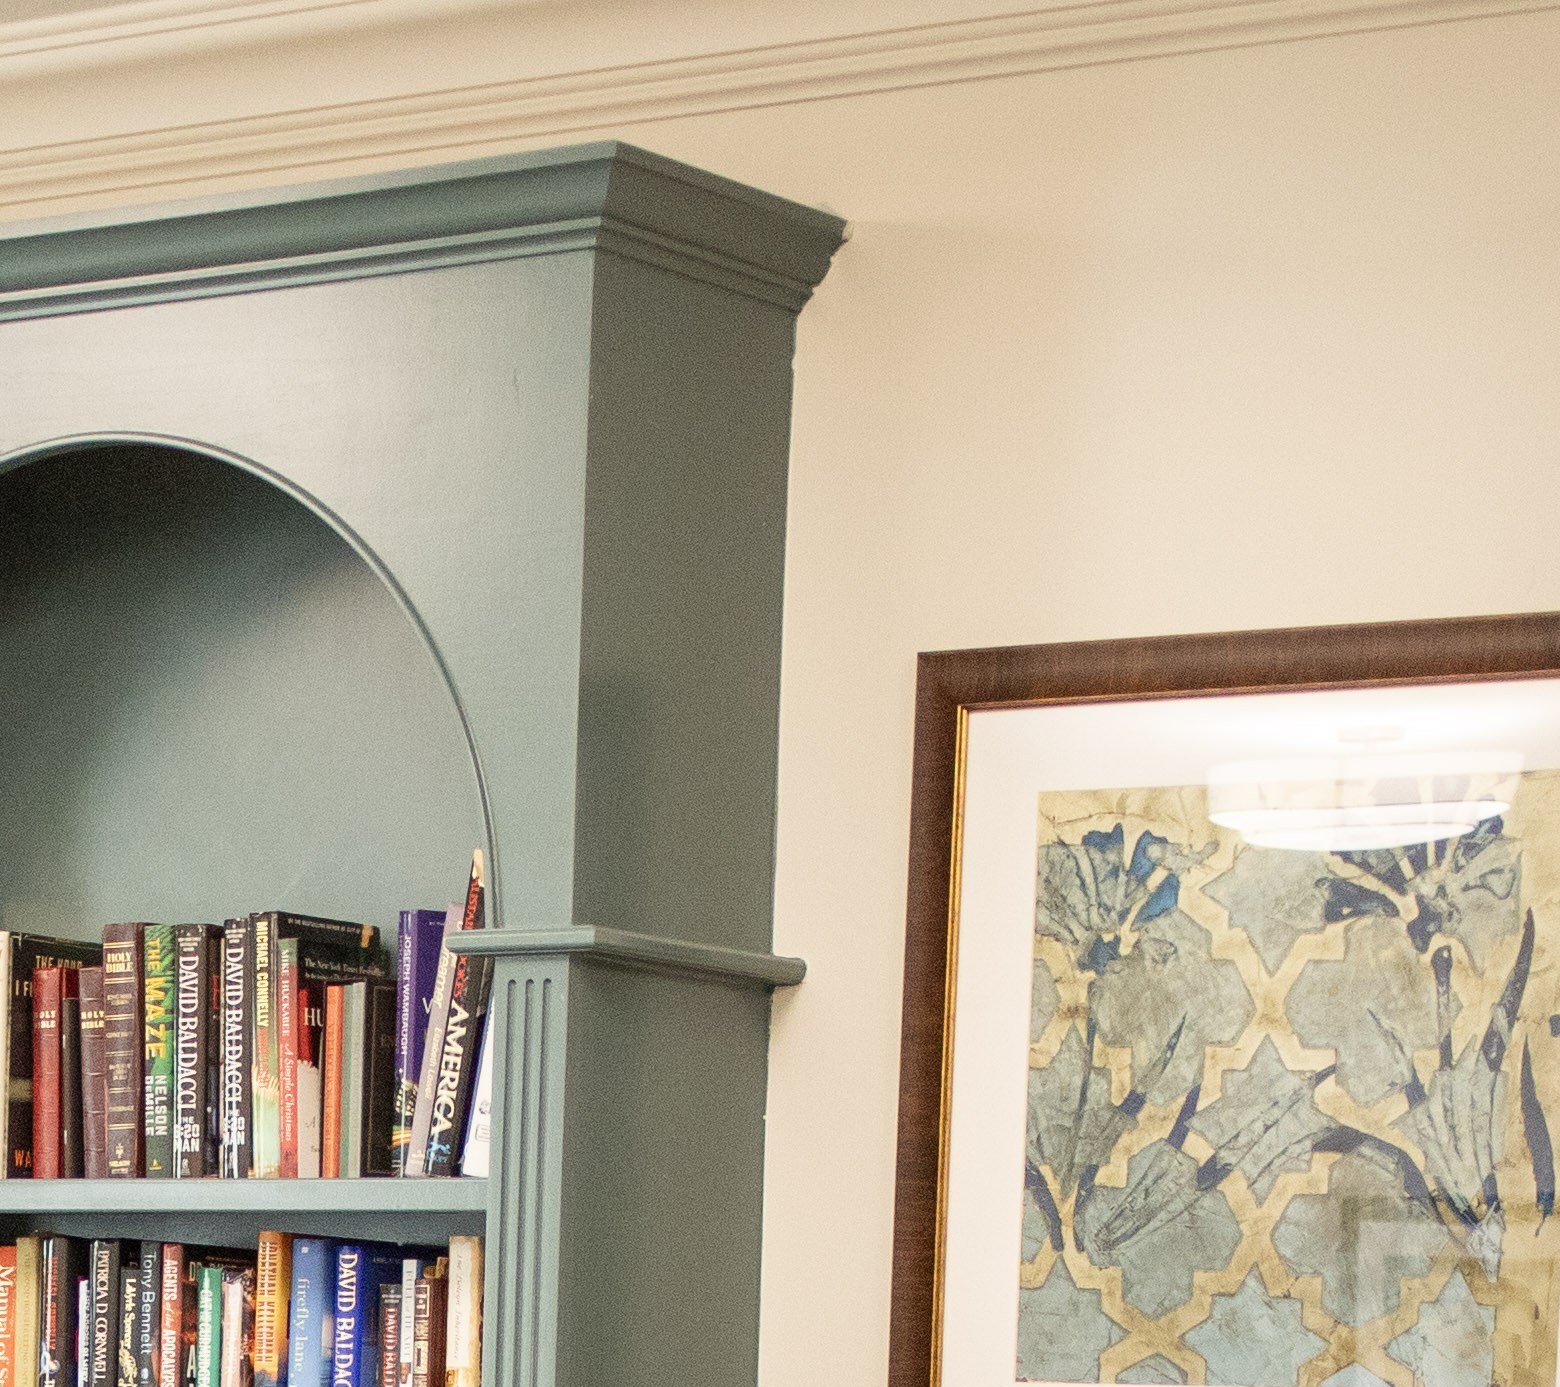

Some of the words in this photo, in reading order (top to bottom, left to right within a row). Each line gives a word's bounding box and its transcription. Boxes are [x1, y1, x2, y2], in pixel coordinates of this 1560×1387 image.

[148, 939, 161, 972] THE
[256, 920, 269, 970] MICHAEL
[282, 948, 291, 977] MIKE
[402, 935, 413, 980] JOSEPH
[179, 955, 200, 1012] DAVID
[256, 972, 269, 1028] CONNELLY
[281, 979, 291, 1037] HUCKABEE
[145, 976, 167, 1061] MAZE
[399, 983, 412, 1056] WAMBAUGH
[177, 1015, 198, 1112] BALDACCI
[430, 1000, 471, 1135] AMERICA
[154, 1074, 168, 1137] NELSON
[141, 1252, 157, 1288] Tony
[337, 1252, 358, 1313] DAVID
[141, 1291, 157, 1355] Bennett
[293, 1277, 310, 1331] firefly
[293, 1335, 308, 1373] lane
